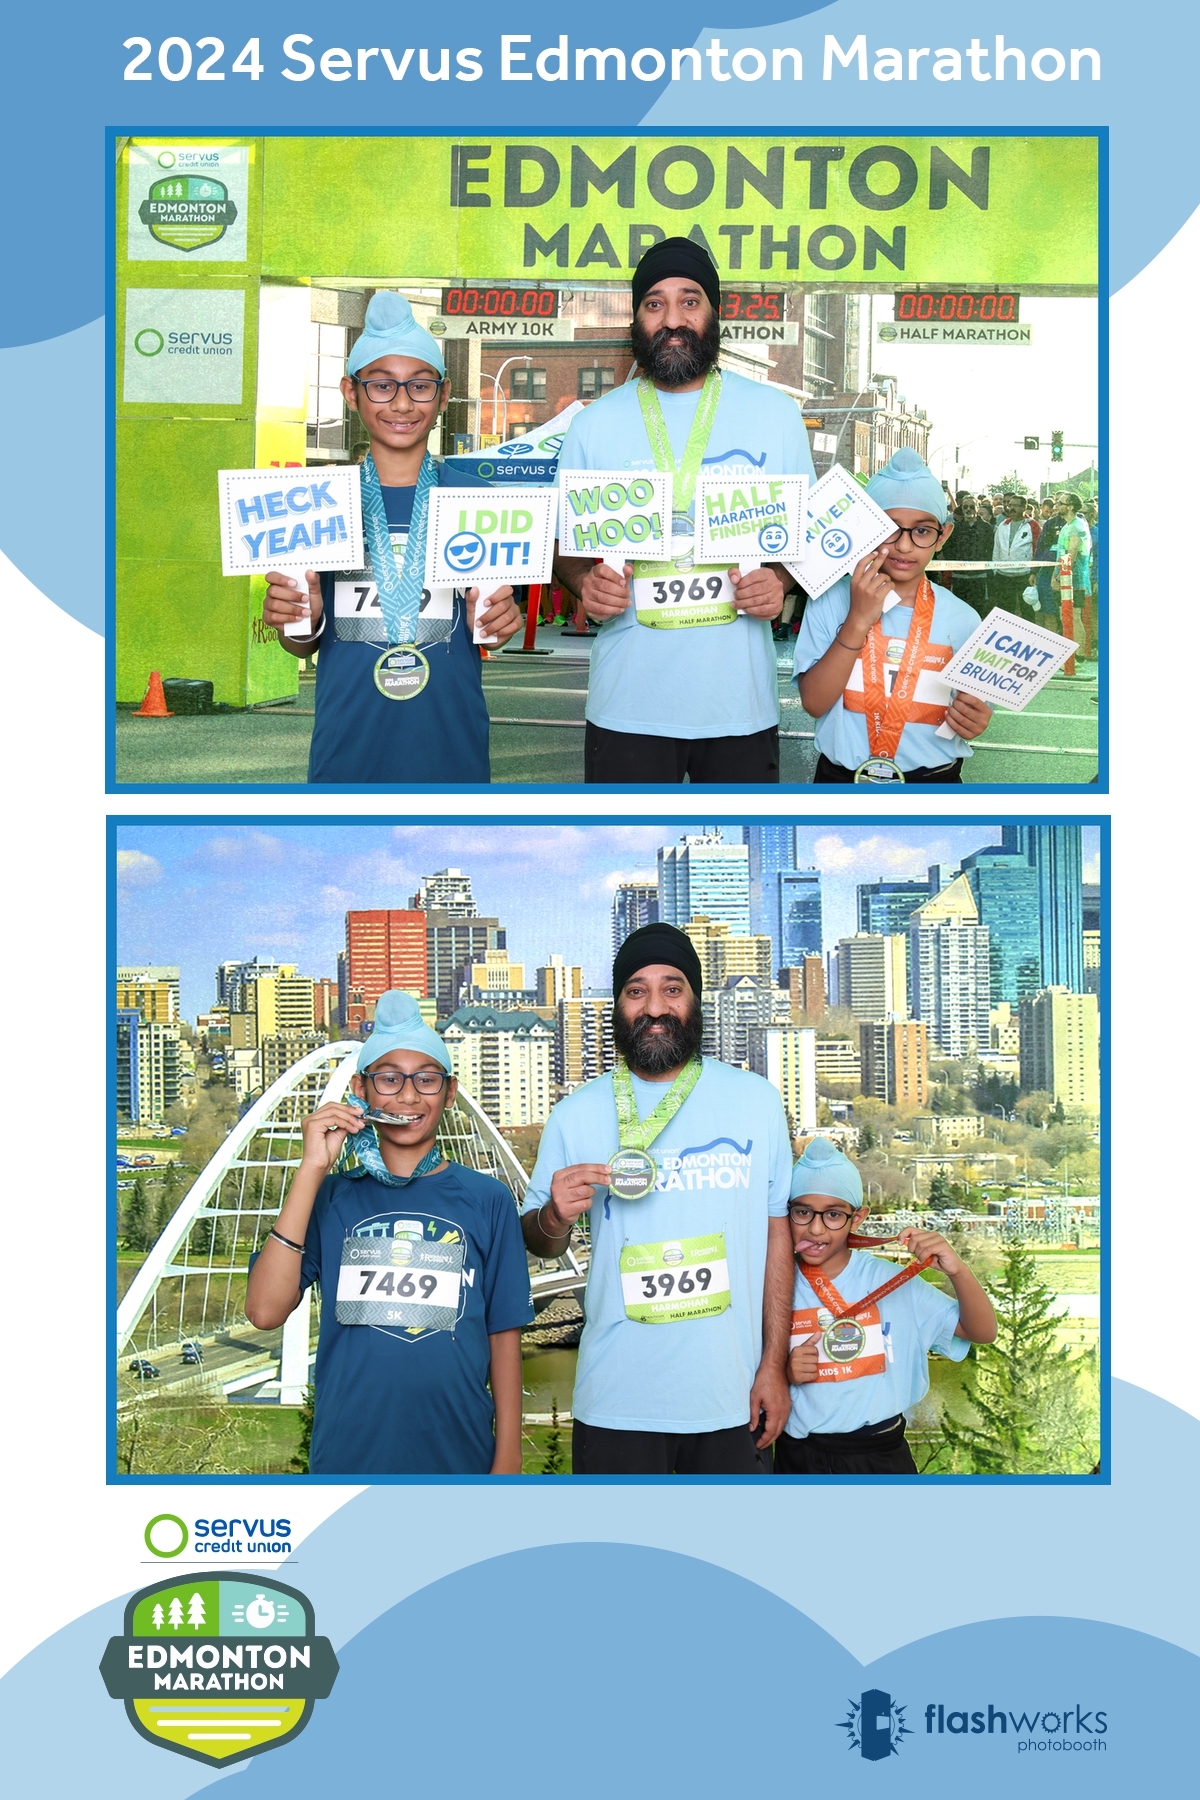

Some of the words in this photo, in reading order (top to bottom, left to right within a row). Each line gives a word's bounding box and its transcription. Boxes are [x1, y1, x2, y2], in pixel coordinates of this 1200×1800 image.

[178, 152, 219, 160] servus
[450, 145, 990, 211] EDMONTON
[150, 203, 226, 213] EDMONTON
[168, 332, 232, 344] servus
[466, 321, 517, 335] ARMY
[522, 322, 554, 336] 10K
[720, 326, 784, 339] ATHON
[900, 328, 939, 339] HALF
[943, 329, 1030, 340] MARATHON
[168, 346, 200, 354] credit
[497, 466, 545, 475] servus
[700, 464, 766, 475] MONTON
[235, 481, 337, 526] HECK
[568, 478, 654, 516] WOO
[705, 480, 783, 516] HALF
[458, 510, 467, 532] I
[475, 510, 533, 534] DID
[709, 502, 786, 527] MARATHON
[241, 515, 348, 562] YEAH!
[573, 512, 663, 551] HOO!
[709, 513, 788, 541] FINISHER!
[490, 542, 530, 566] IT!
[354, 587, 431, 612] 749
[653, 576, 723, 604] 3969
[662, 606, 718, 618] HARMOHAN
[696, 615, 731, 623] MARATHON
[984, 630, 998, 645] I
[994, 635, 1054, 667] CAN'T
[902, 668, 913, 690] servus
[909, 644, 918, 667] credit
[973, 648, 1013, 670] WAIT
[1008, 663, 1038, 682] FOR
[960, 662, 1023, 696] BRUNCH.
[663, 1153, 752, 1170] EDMONTON
[650, 1167, 750, 1192] RATHON
[360, 1271, 438, 1300] 7469
[641, 1268, 712, 1298] 3969
[387, 1311, 402, 1320] 5K
[652, 1297, 708, 1312] HARMOHAN
[687, 1306, 722, 1316] MARATHON
[833, 1302, 845, 1313] cred
[819, 1368, 838, 1376] KIDS
